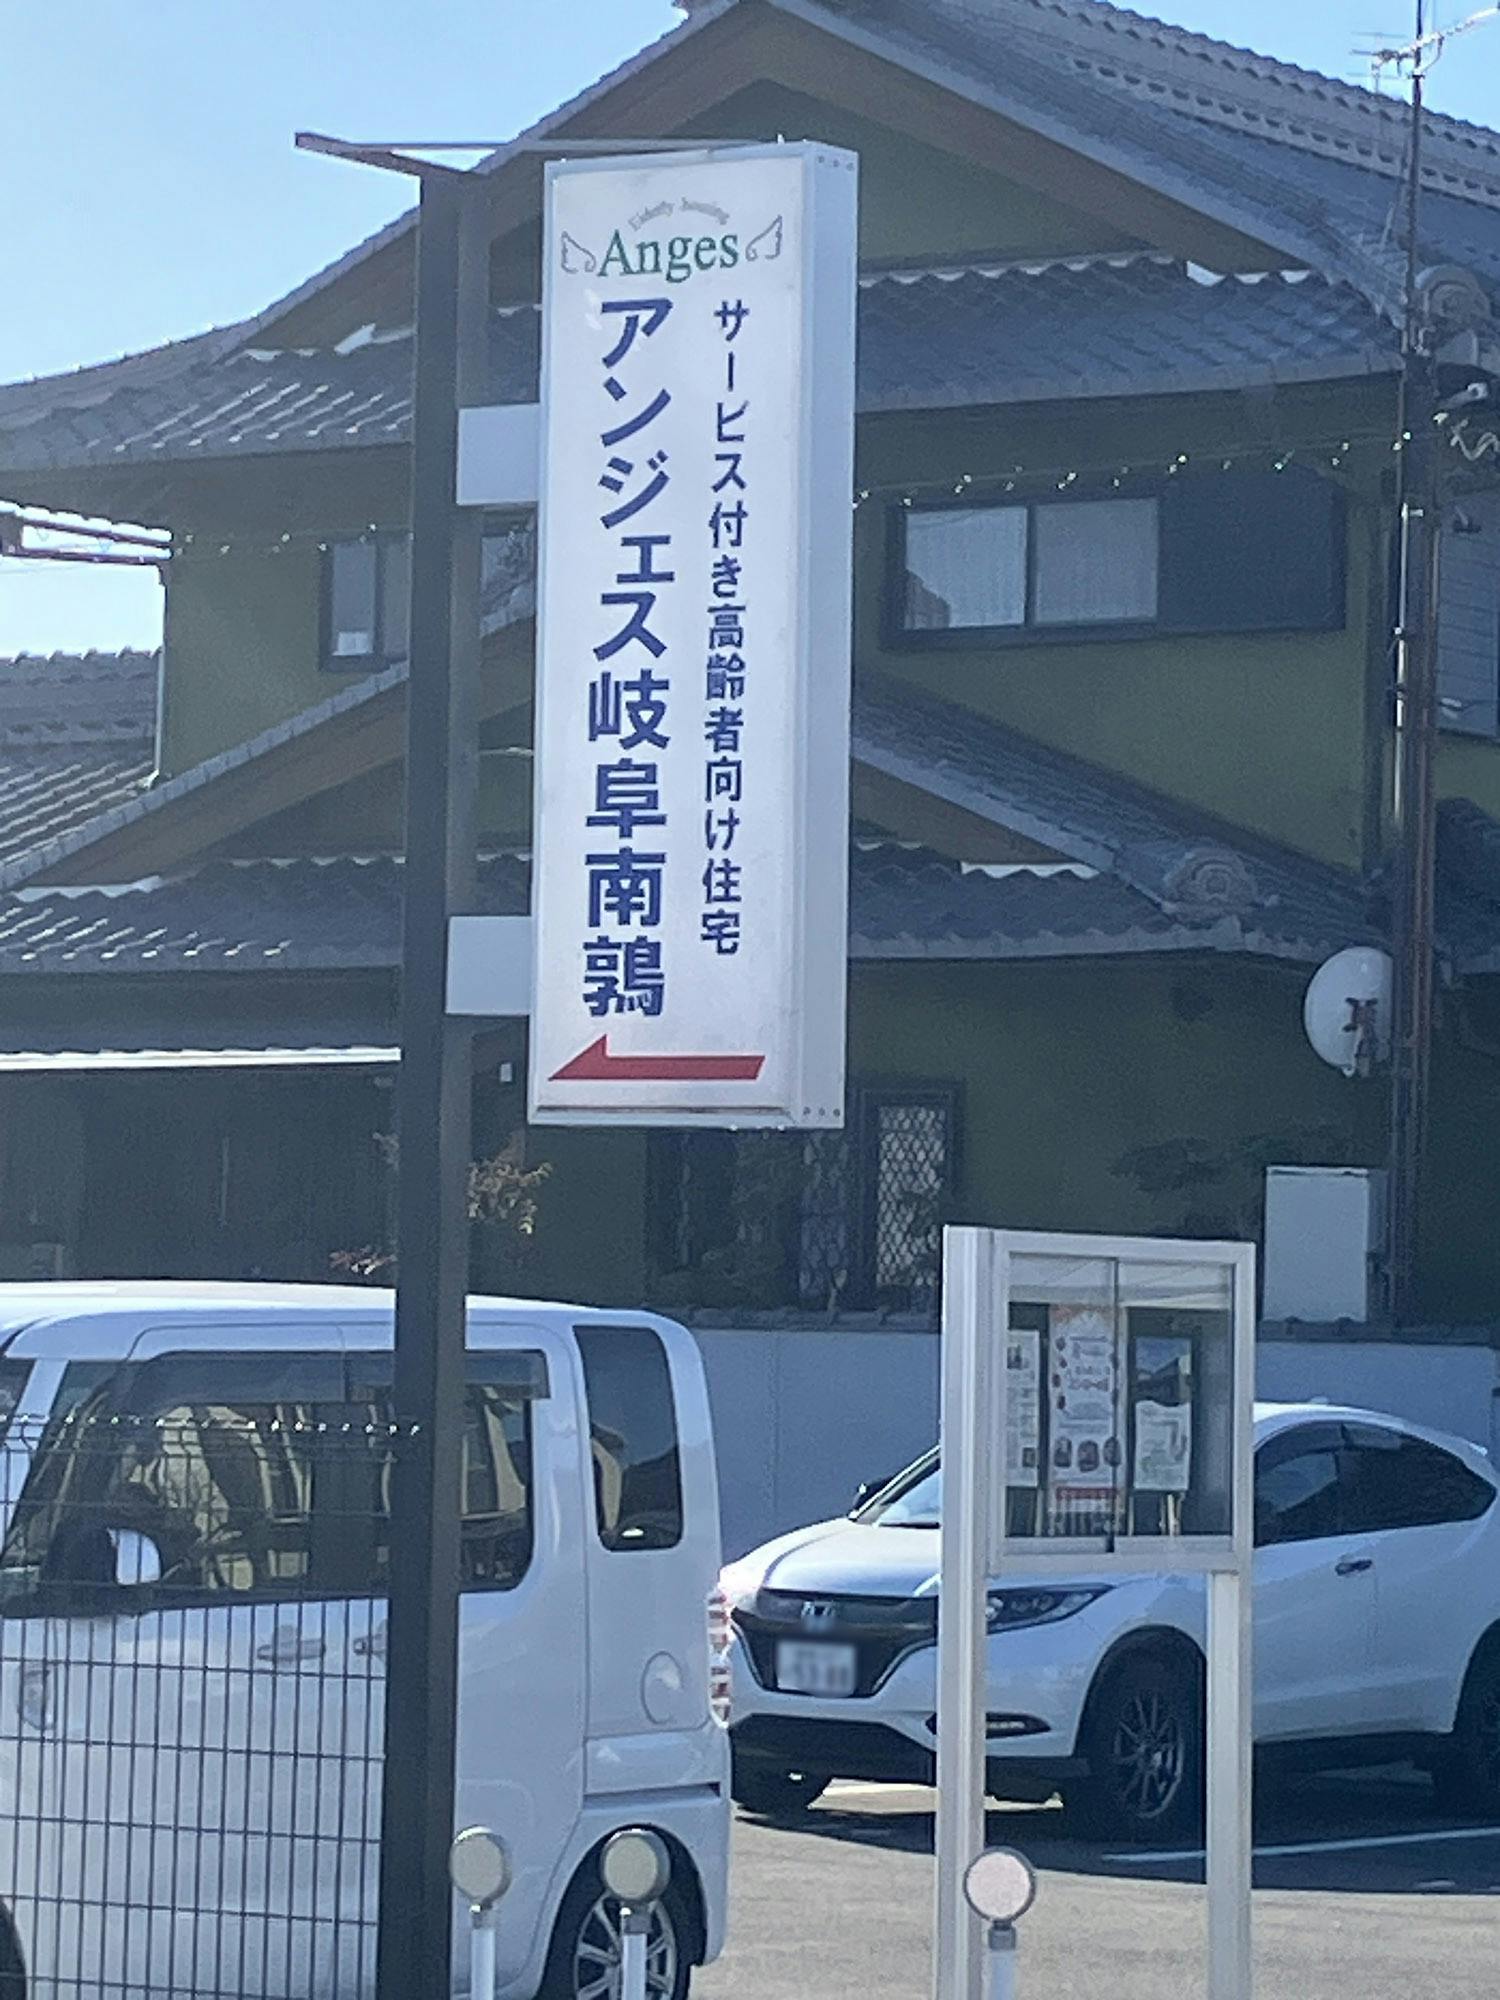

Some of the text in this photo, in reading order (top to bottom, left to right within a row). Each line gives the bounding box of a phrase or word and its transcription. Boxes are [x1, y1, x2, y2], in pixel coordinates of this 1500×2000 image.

[597, 229, 738, 283] Anges
[583, 297, 675, 1017] アンジェス岐阜南鶉
[700, 299, 749, 955] サービス付き高齢者向け住宅
